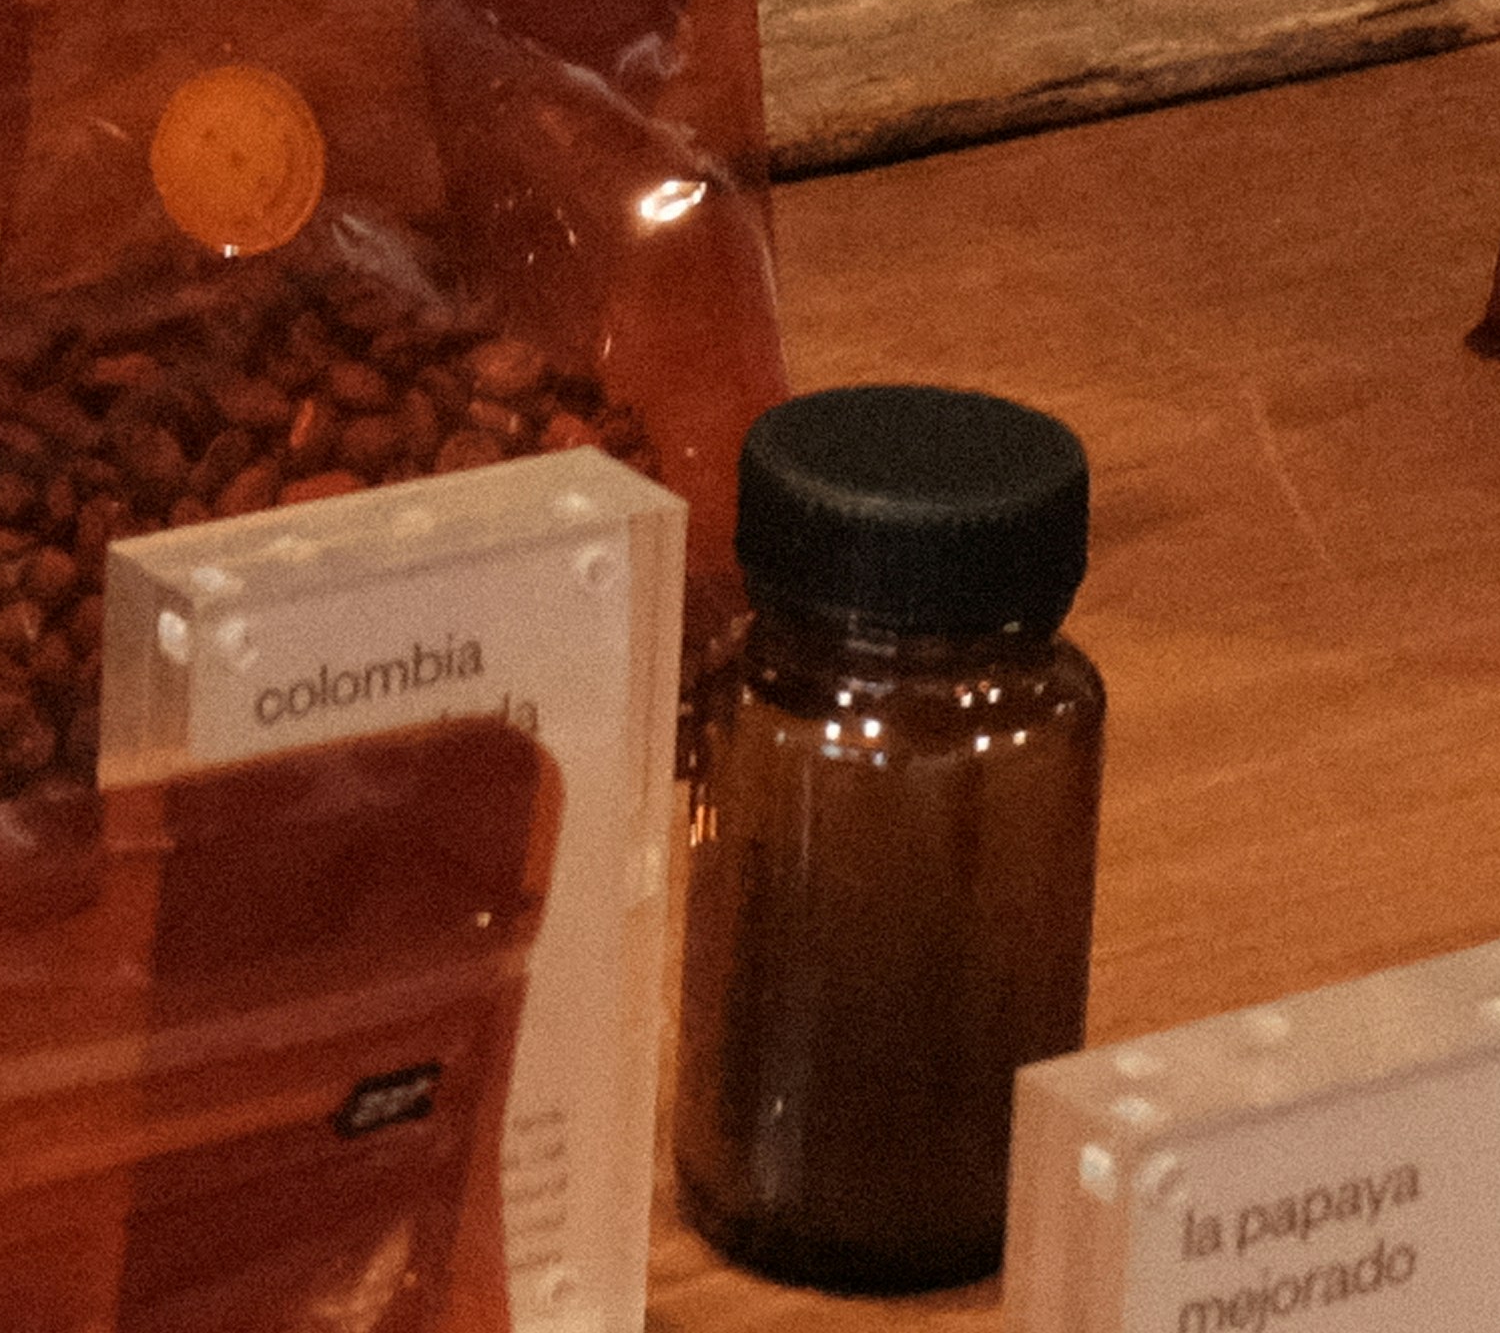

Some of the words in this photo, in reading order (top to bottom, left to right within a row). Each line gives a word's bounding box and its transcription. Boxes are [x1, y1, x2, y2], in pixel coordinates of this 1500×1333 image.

[254, 635, 485, 726] colombia
[1181, 1206, 1223, 1262] la
[1235, 1163, 1420, 1258] papaya
[1178, 1238, 1417, 1333] mejorado
